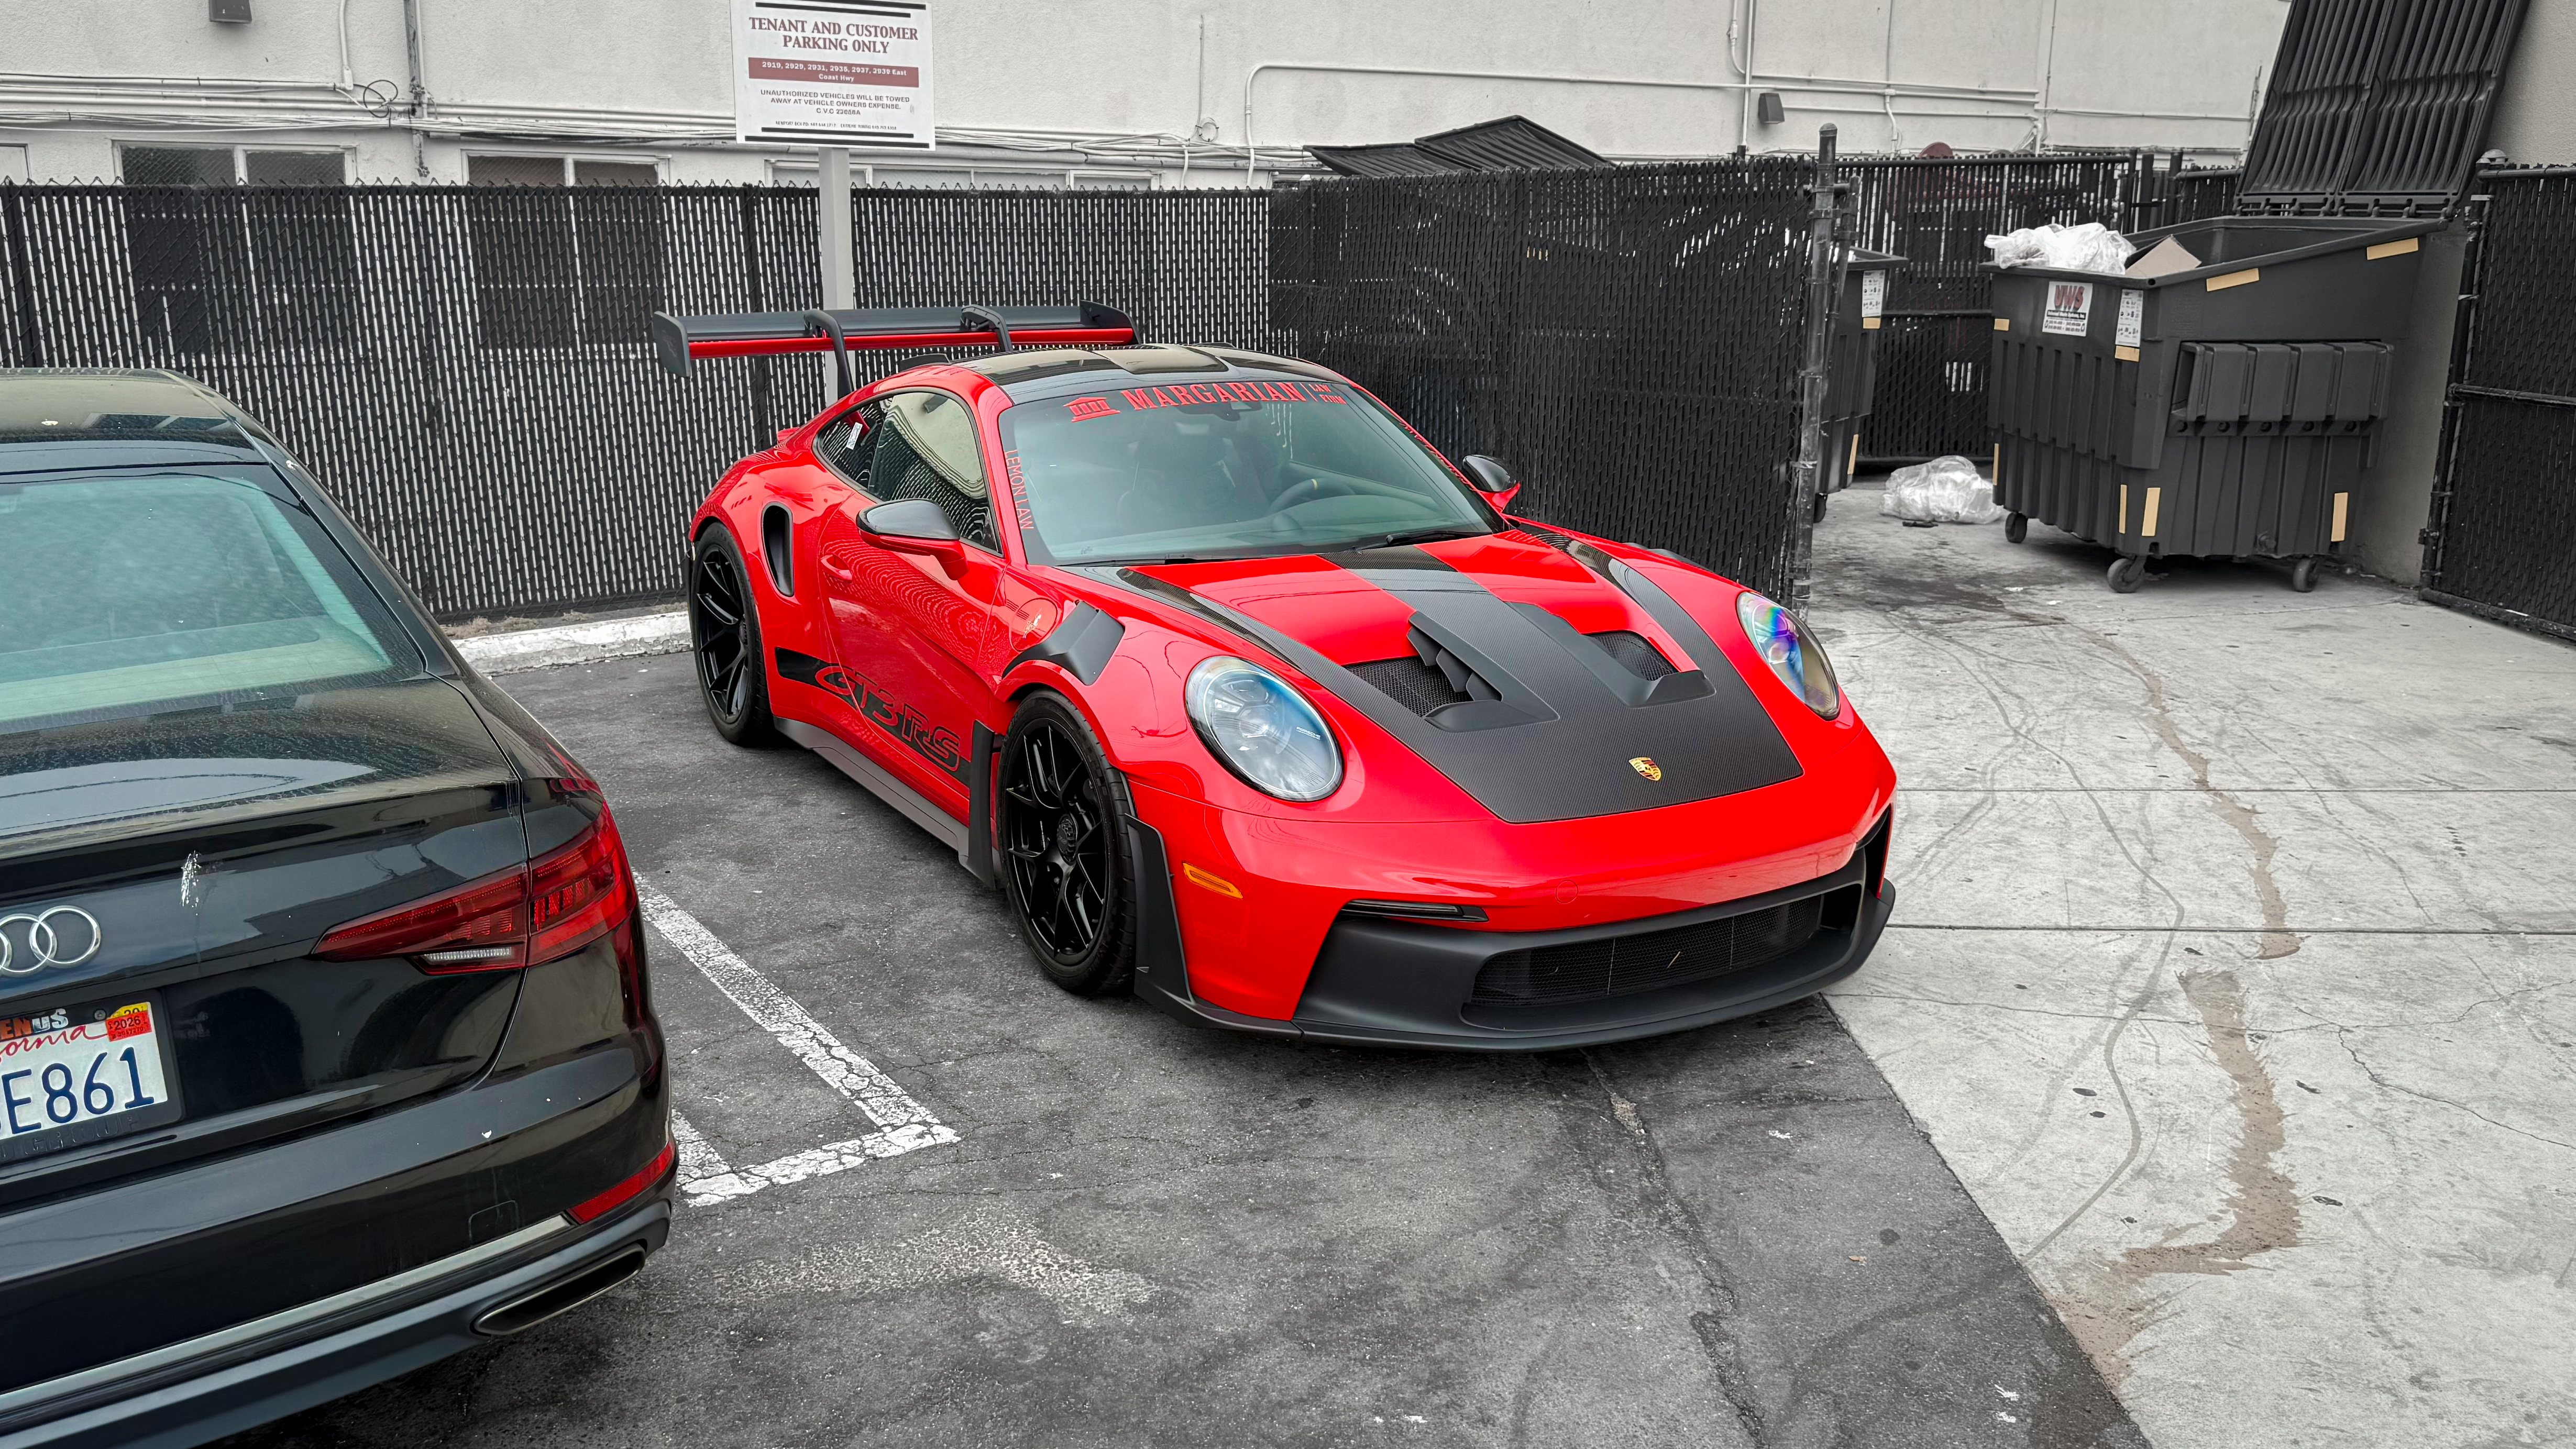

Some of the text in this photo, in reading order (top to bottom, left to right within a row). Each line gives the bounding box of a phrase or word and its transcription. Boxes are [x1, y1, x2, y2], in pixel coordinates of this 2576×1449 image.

[749, 17, 918, 40] TENANT AND CUSTOMER
[783, 35, 889, 53] PARKING ONLY
[761, 90, 818, 98] UNAUTHORIZED
[2054, 284, 2085, 309] UWS
[1121, 382, 1307, 410] MARGARIAN
[1308, 384, 1331, 392] LAW
[1005, 449, 1034, 529] LEMON LAW
[114, 1016, 141, 1031] 2026
[0, 1025, 108, 1063] ornia
[0, 1046, 155, 1135] E861
